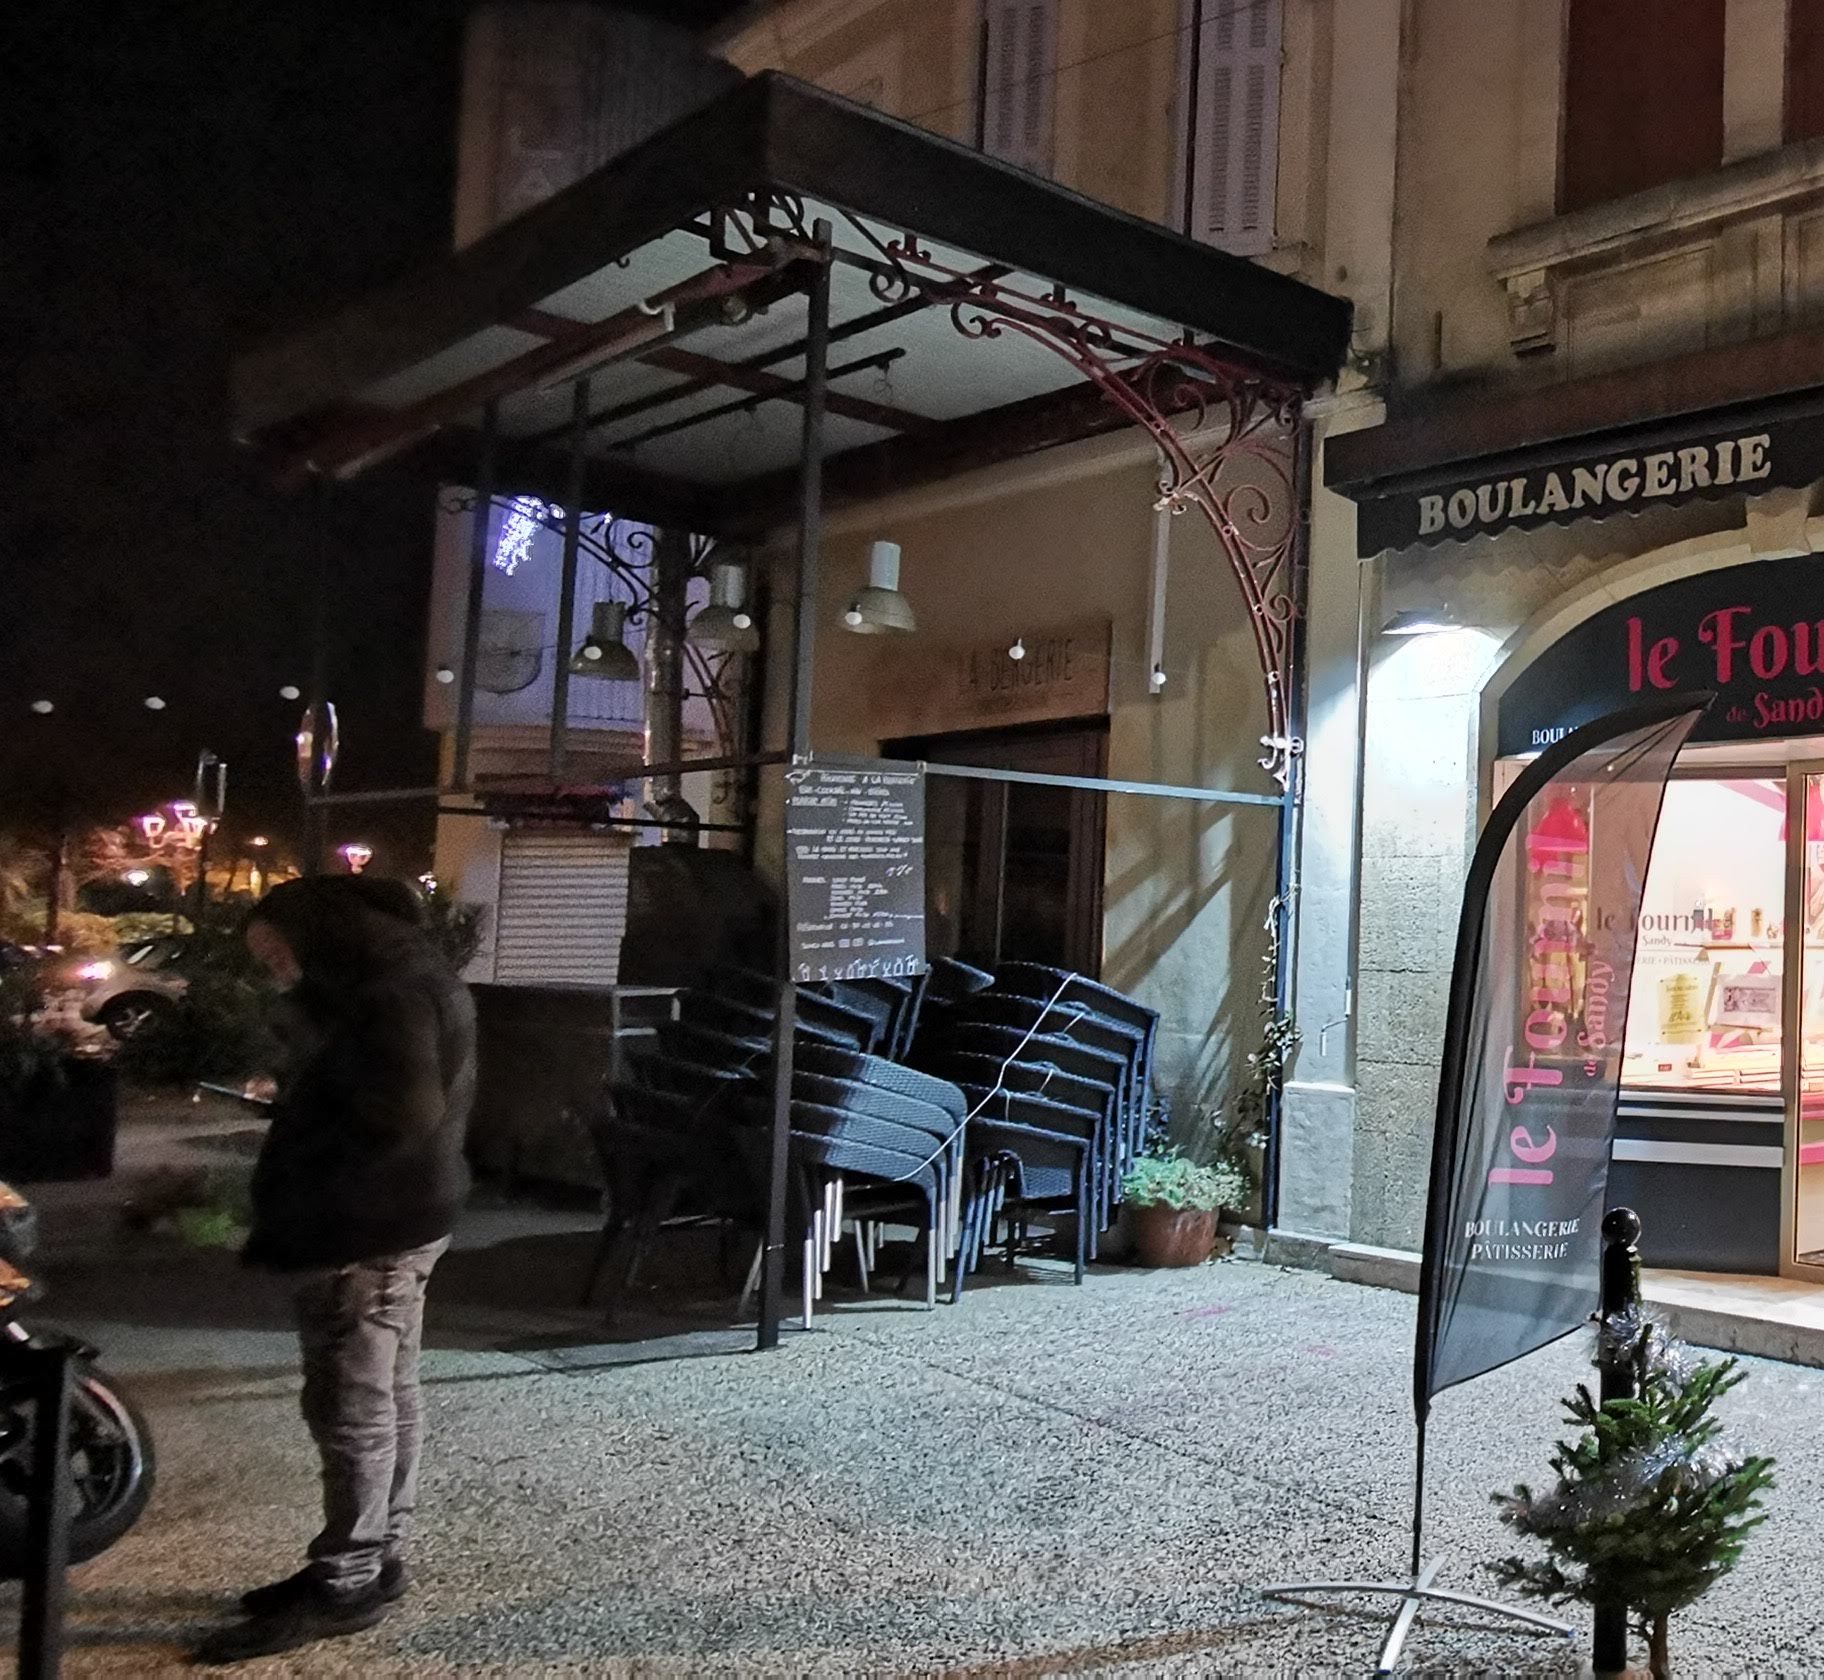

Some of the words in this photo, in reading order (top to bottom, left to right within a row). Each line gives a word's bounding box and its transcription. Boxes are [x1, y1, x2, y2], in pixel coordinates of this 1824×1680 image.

[1417, 433, 1772, 536] BOULANGERIE
[1628, 615, 1681, 692] le
[1726, 706, 1749, 724] de
[1464, 1217, 1581, 1239] BOULANGERIE
[1470, 1239, 1569, 1260] PÂTISSERIE
